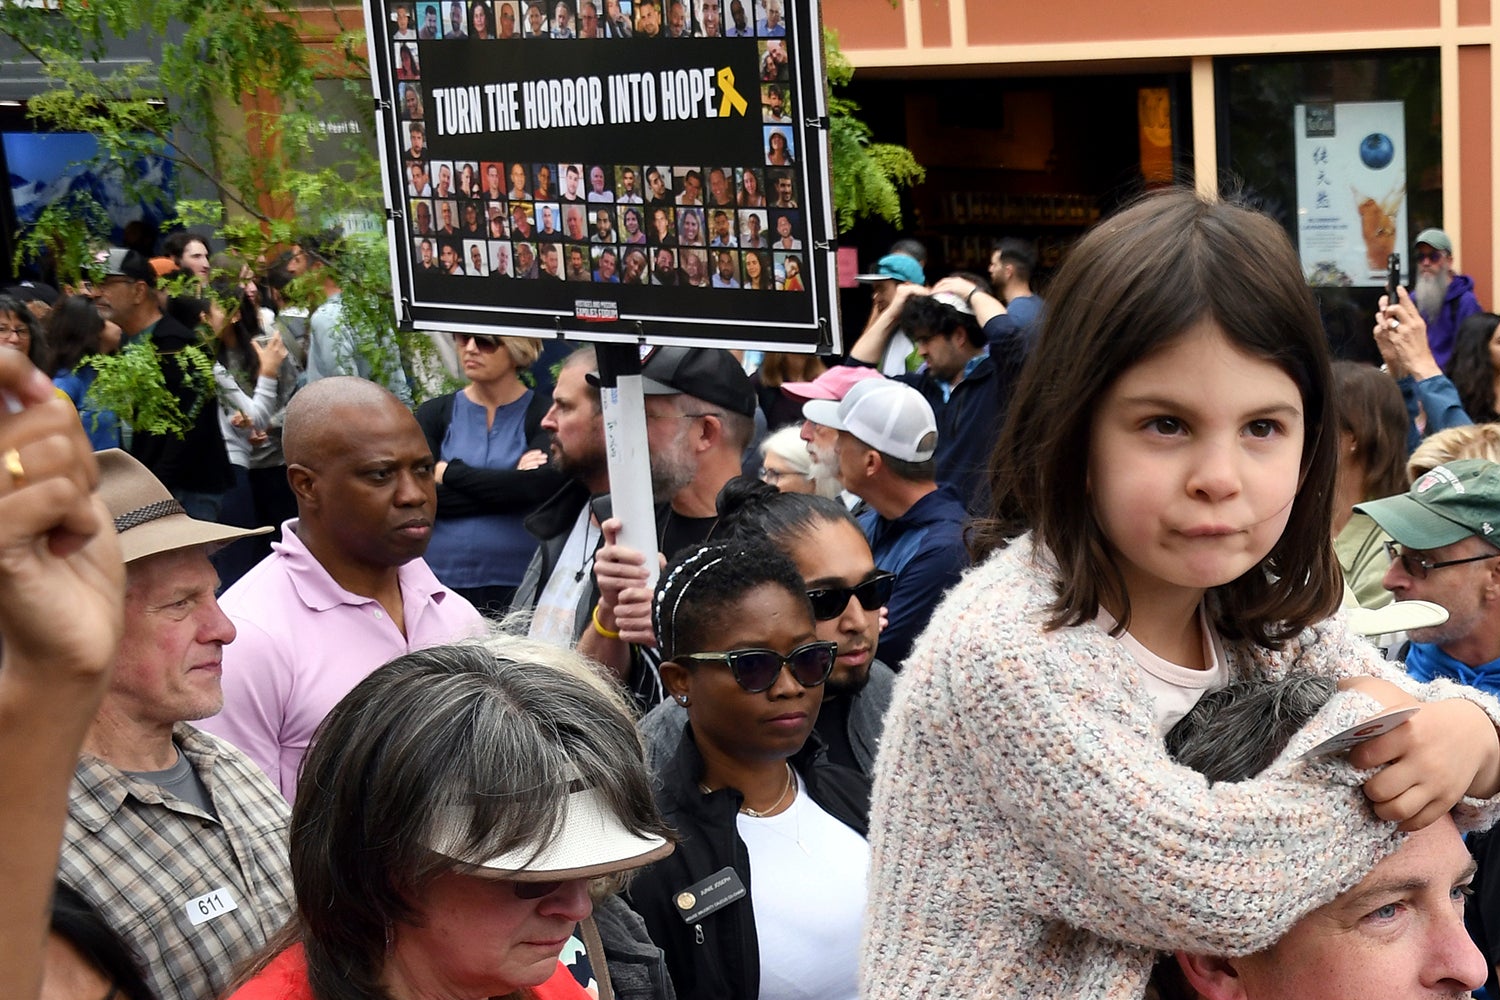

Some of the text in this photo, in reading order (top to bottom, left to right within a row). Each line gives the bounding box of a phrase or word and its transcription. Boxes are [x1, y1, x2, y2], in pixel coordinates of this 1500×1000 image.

[432, 67, 718, 135] TURN THE HORROR INTO HOPE
[198, 894, 224, 915] 611
